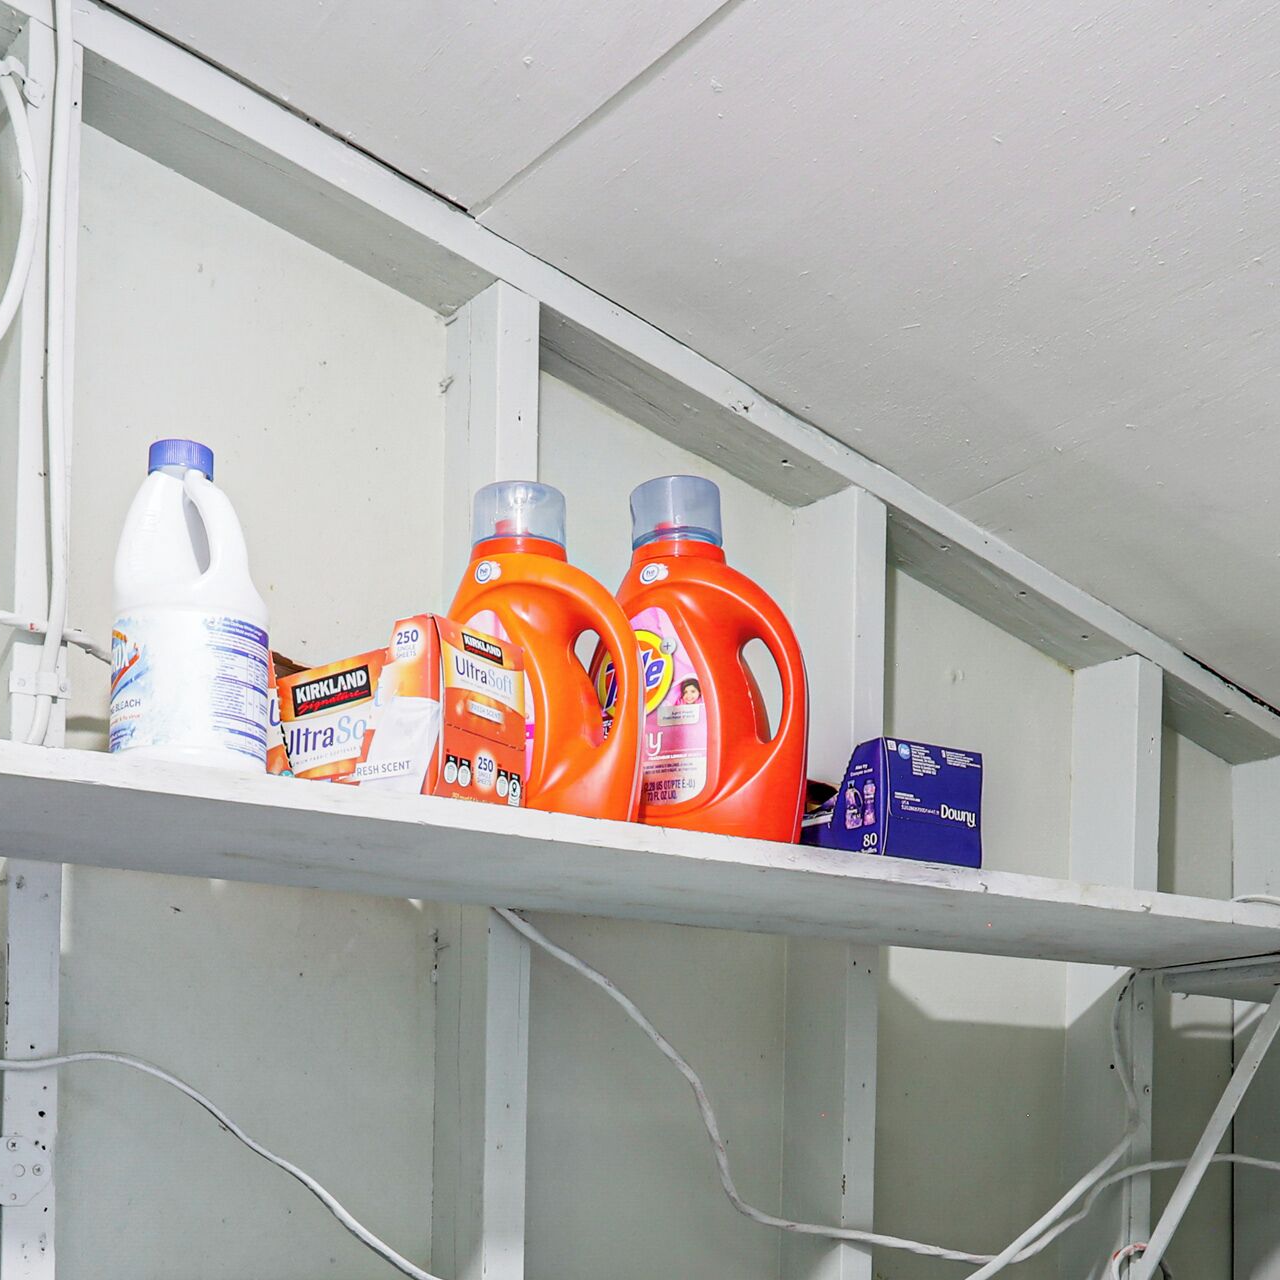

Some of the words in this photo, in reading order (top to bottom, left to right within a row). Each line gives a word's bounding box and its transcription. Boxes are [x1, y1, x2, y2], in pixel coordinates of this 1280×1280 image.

[396, 629, 419, 646] 250
[455, 655, 513, 696] UltraSoft
[295, 669, 368, 705] KIRKLAND
[115, 698, 141, 712] BLEACH
[297, 690, 370, 716] Signature
[356, 765, 379, 778] RESH
[381, 760, 411, 773] SCENT
[477, 756, 494, 773] 250
[940, 804, 976, 828] Downy
[863, 832, 878, 847] 80
